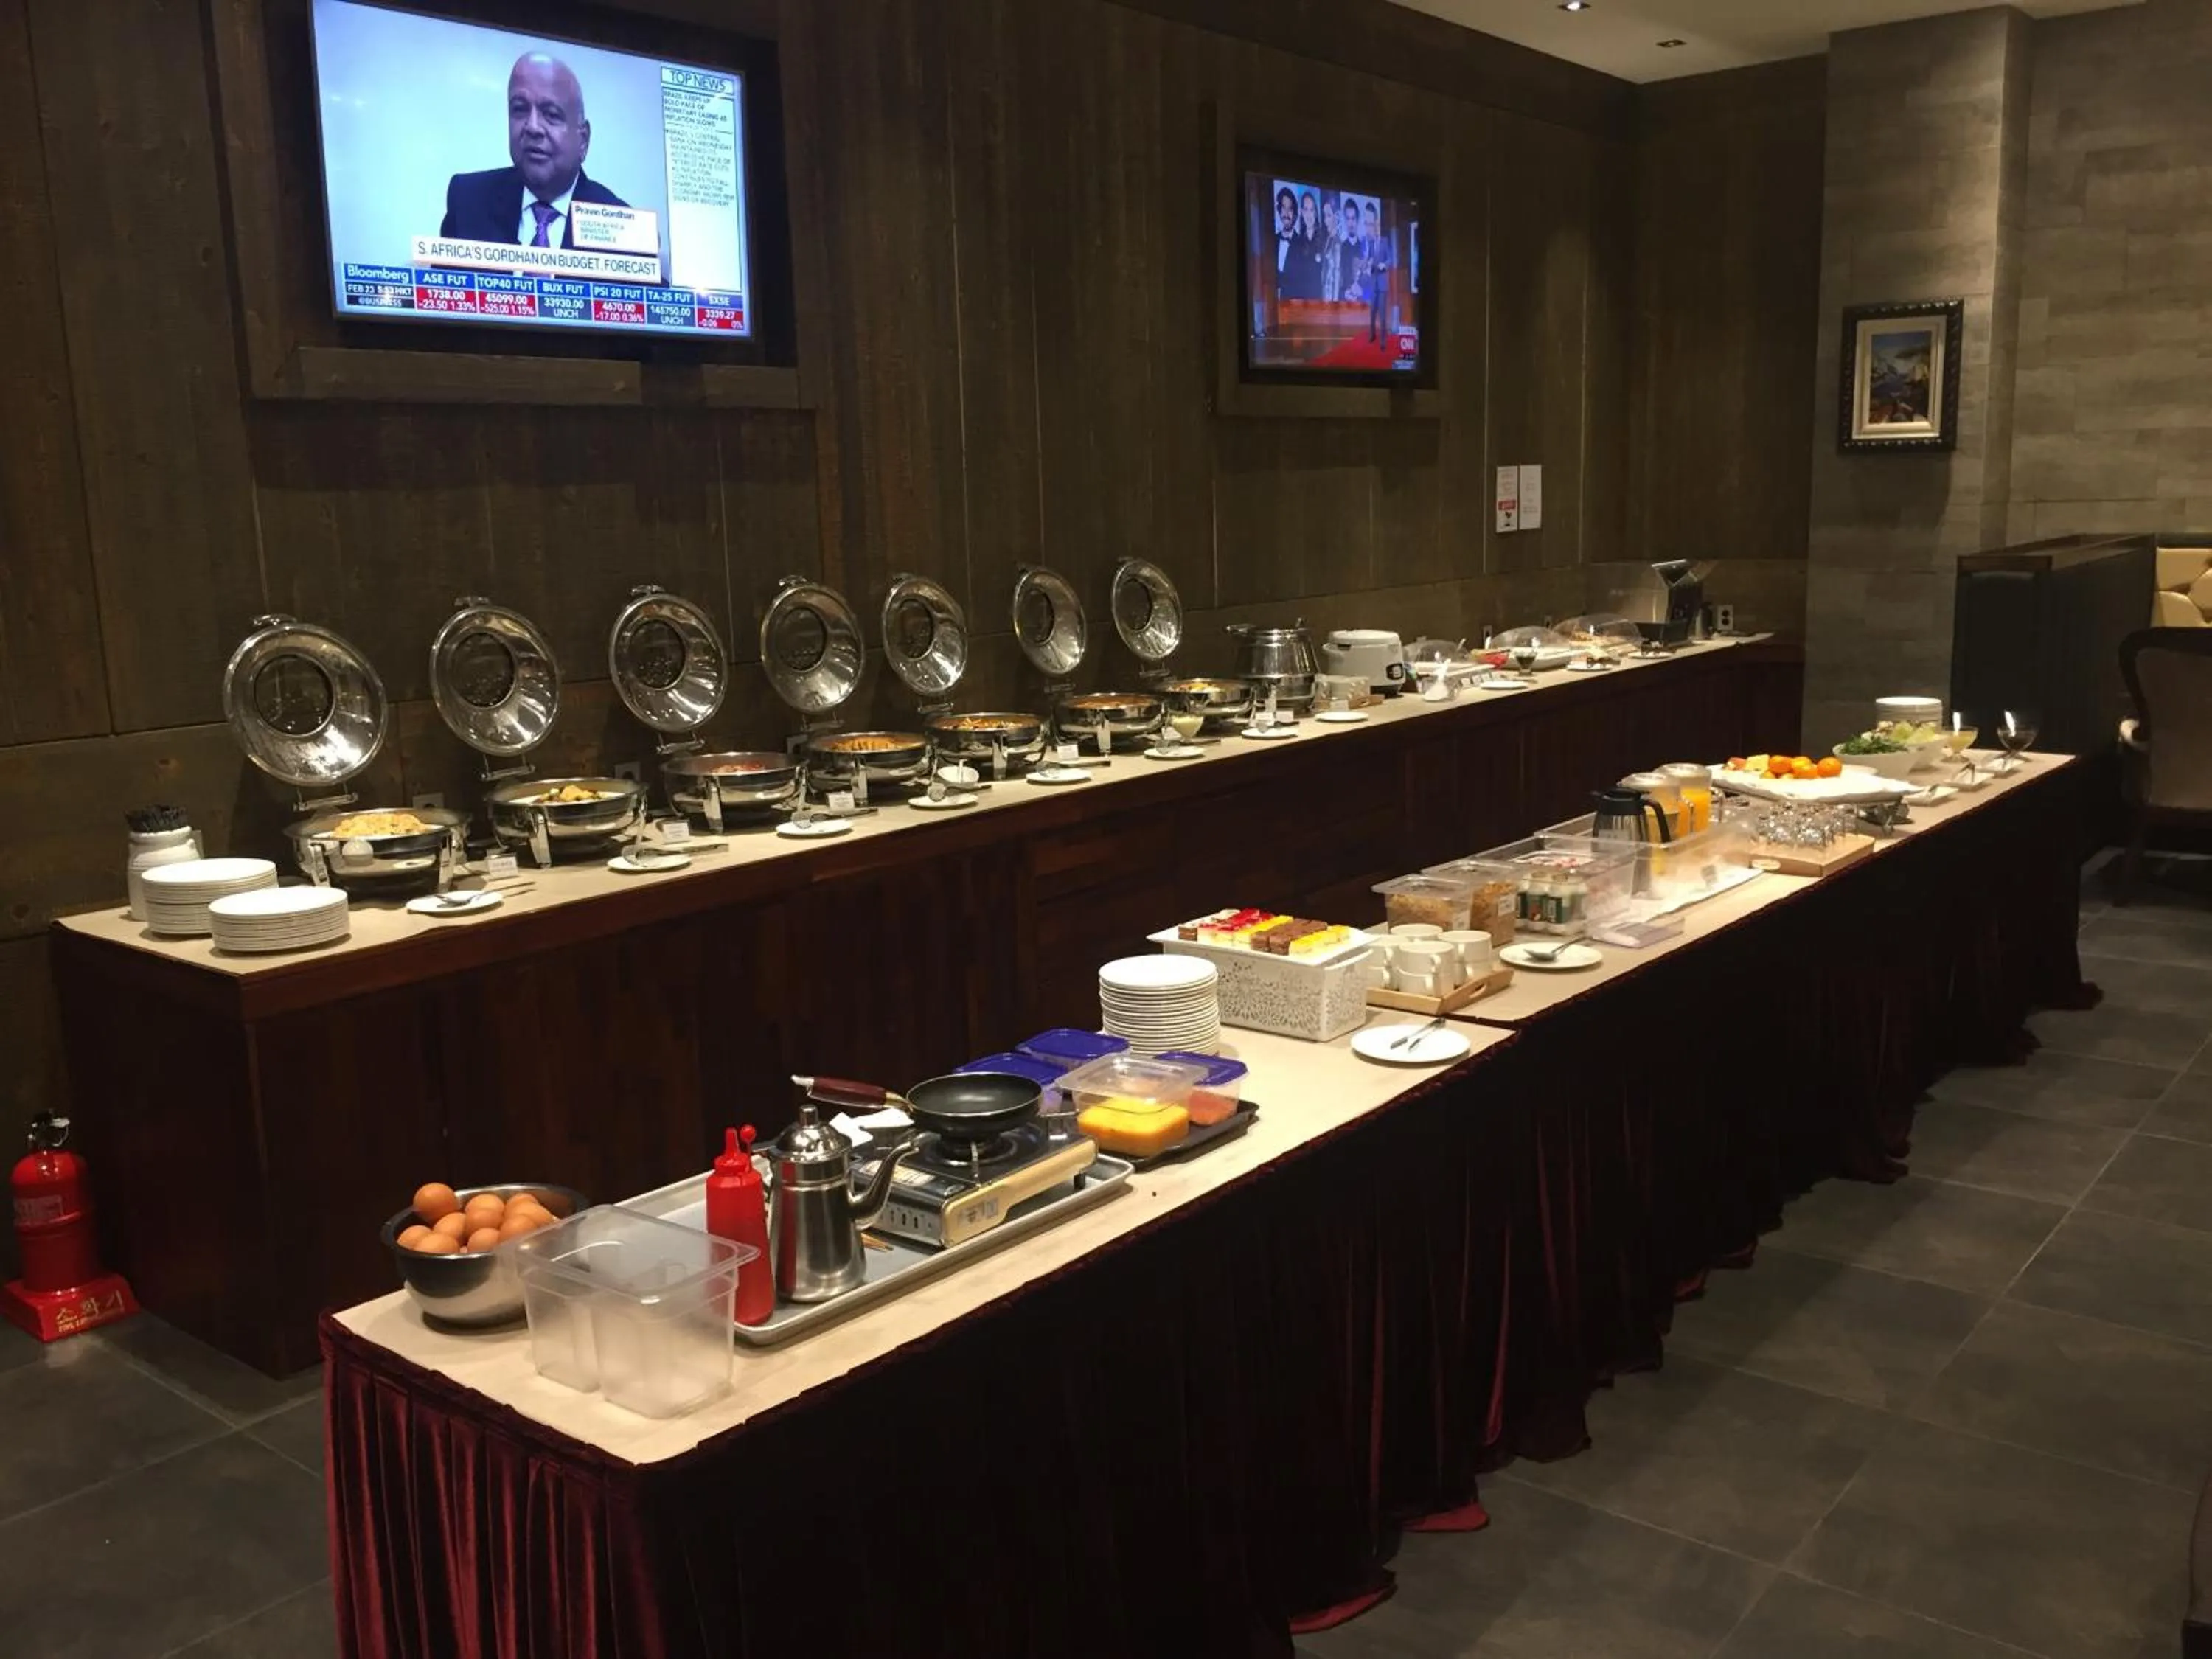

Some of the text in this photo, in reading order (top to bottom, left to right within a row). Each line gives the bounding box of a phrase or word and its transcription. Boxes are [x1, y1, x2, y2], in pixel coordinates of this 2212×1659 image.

[669, 70, 726, 91] TOP NEWS
[418, 242, 427, 254] S.
[431, 243, 482, 259] AFRICA'S
[484, 247, 539, 265] GORDHAN
[540, 251, 557, 267] ON
[605, 259, 657, 276] FORECAST
[347, 265, 409, 283] Bloomberg
[422, 273, 467, 286] ASE FUT
[347, 284, 364, 293] FEB
[365, 285, 375, 293] 23
[479, 278, 533, 291] TOP40 FUT
[542, 282, 584, 294] BUX FUT
[427, 289, 466, 300] 1738.00
[485, 293, 527, 305] 45099.00
[594, 287, 641, 299] PSI 20 FUT
[647, 291, 692, 303] TA-25 FUT
[544, 297, 585, 309] 33930.00
[554, 309, 579, 319] UNCH
[660, 316, 684, 325] UNCH
